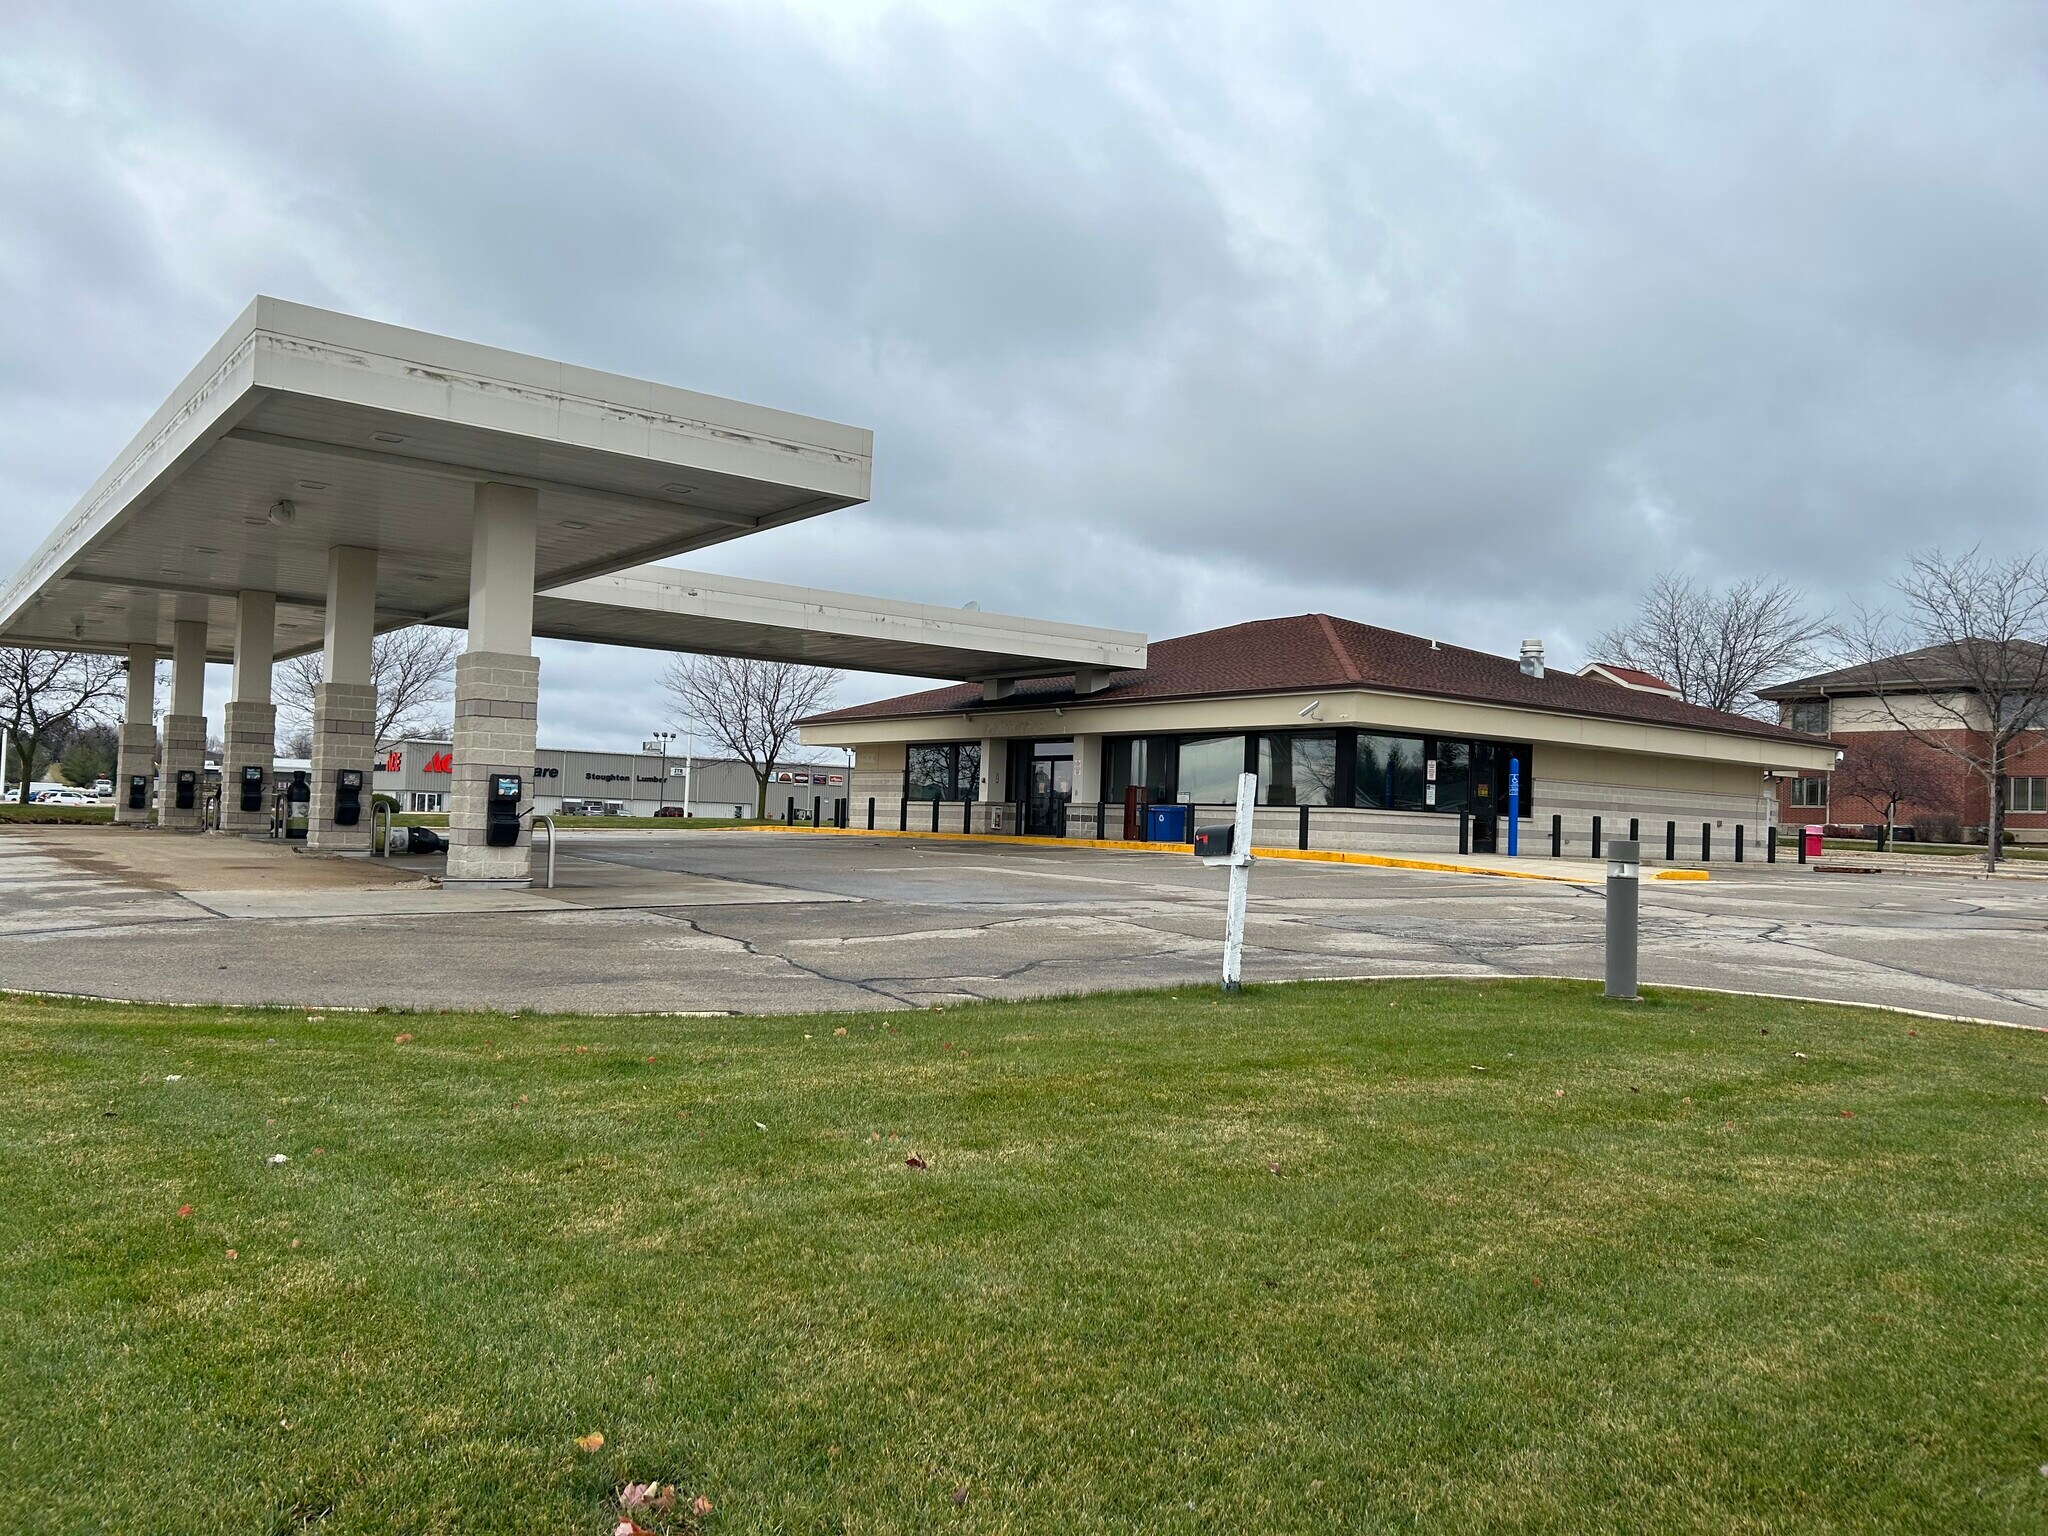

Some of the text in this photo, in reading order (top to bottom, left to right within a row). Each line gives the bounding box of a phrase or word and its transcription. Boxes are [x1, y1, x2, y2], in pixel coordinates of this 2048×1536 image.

[386, 751, 402, 772] ACE
[423, 751, 559, 779] AC are
[585, 772, 668, 783] Stoughton Lumber
